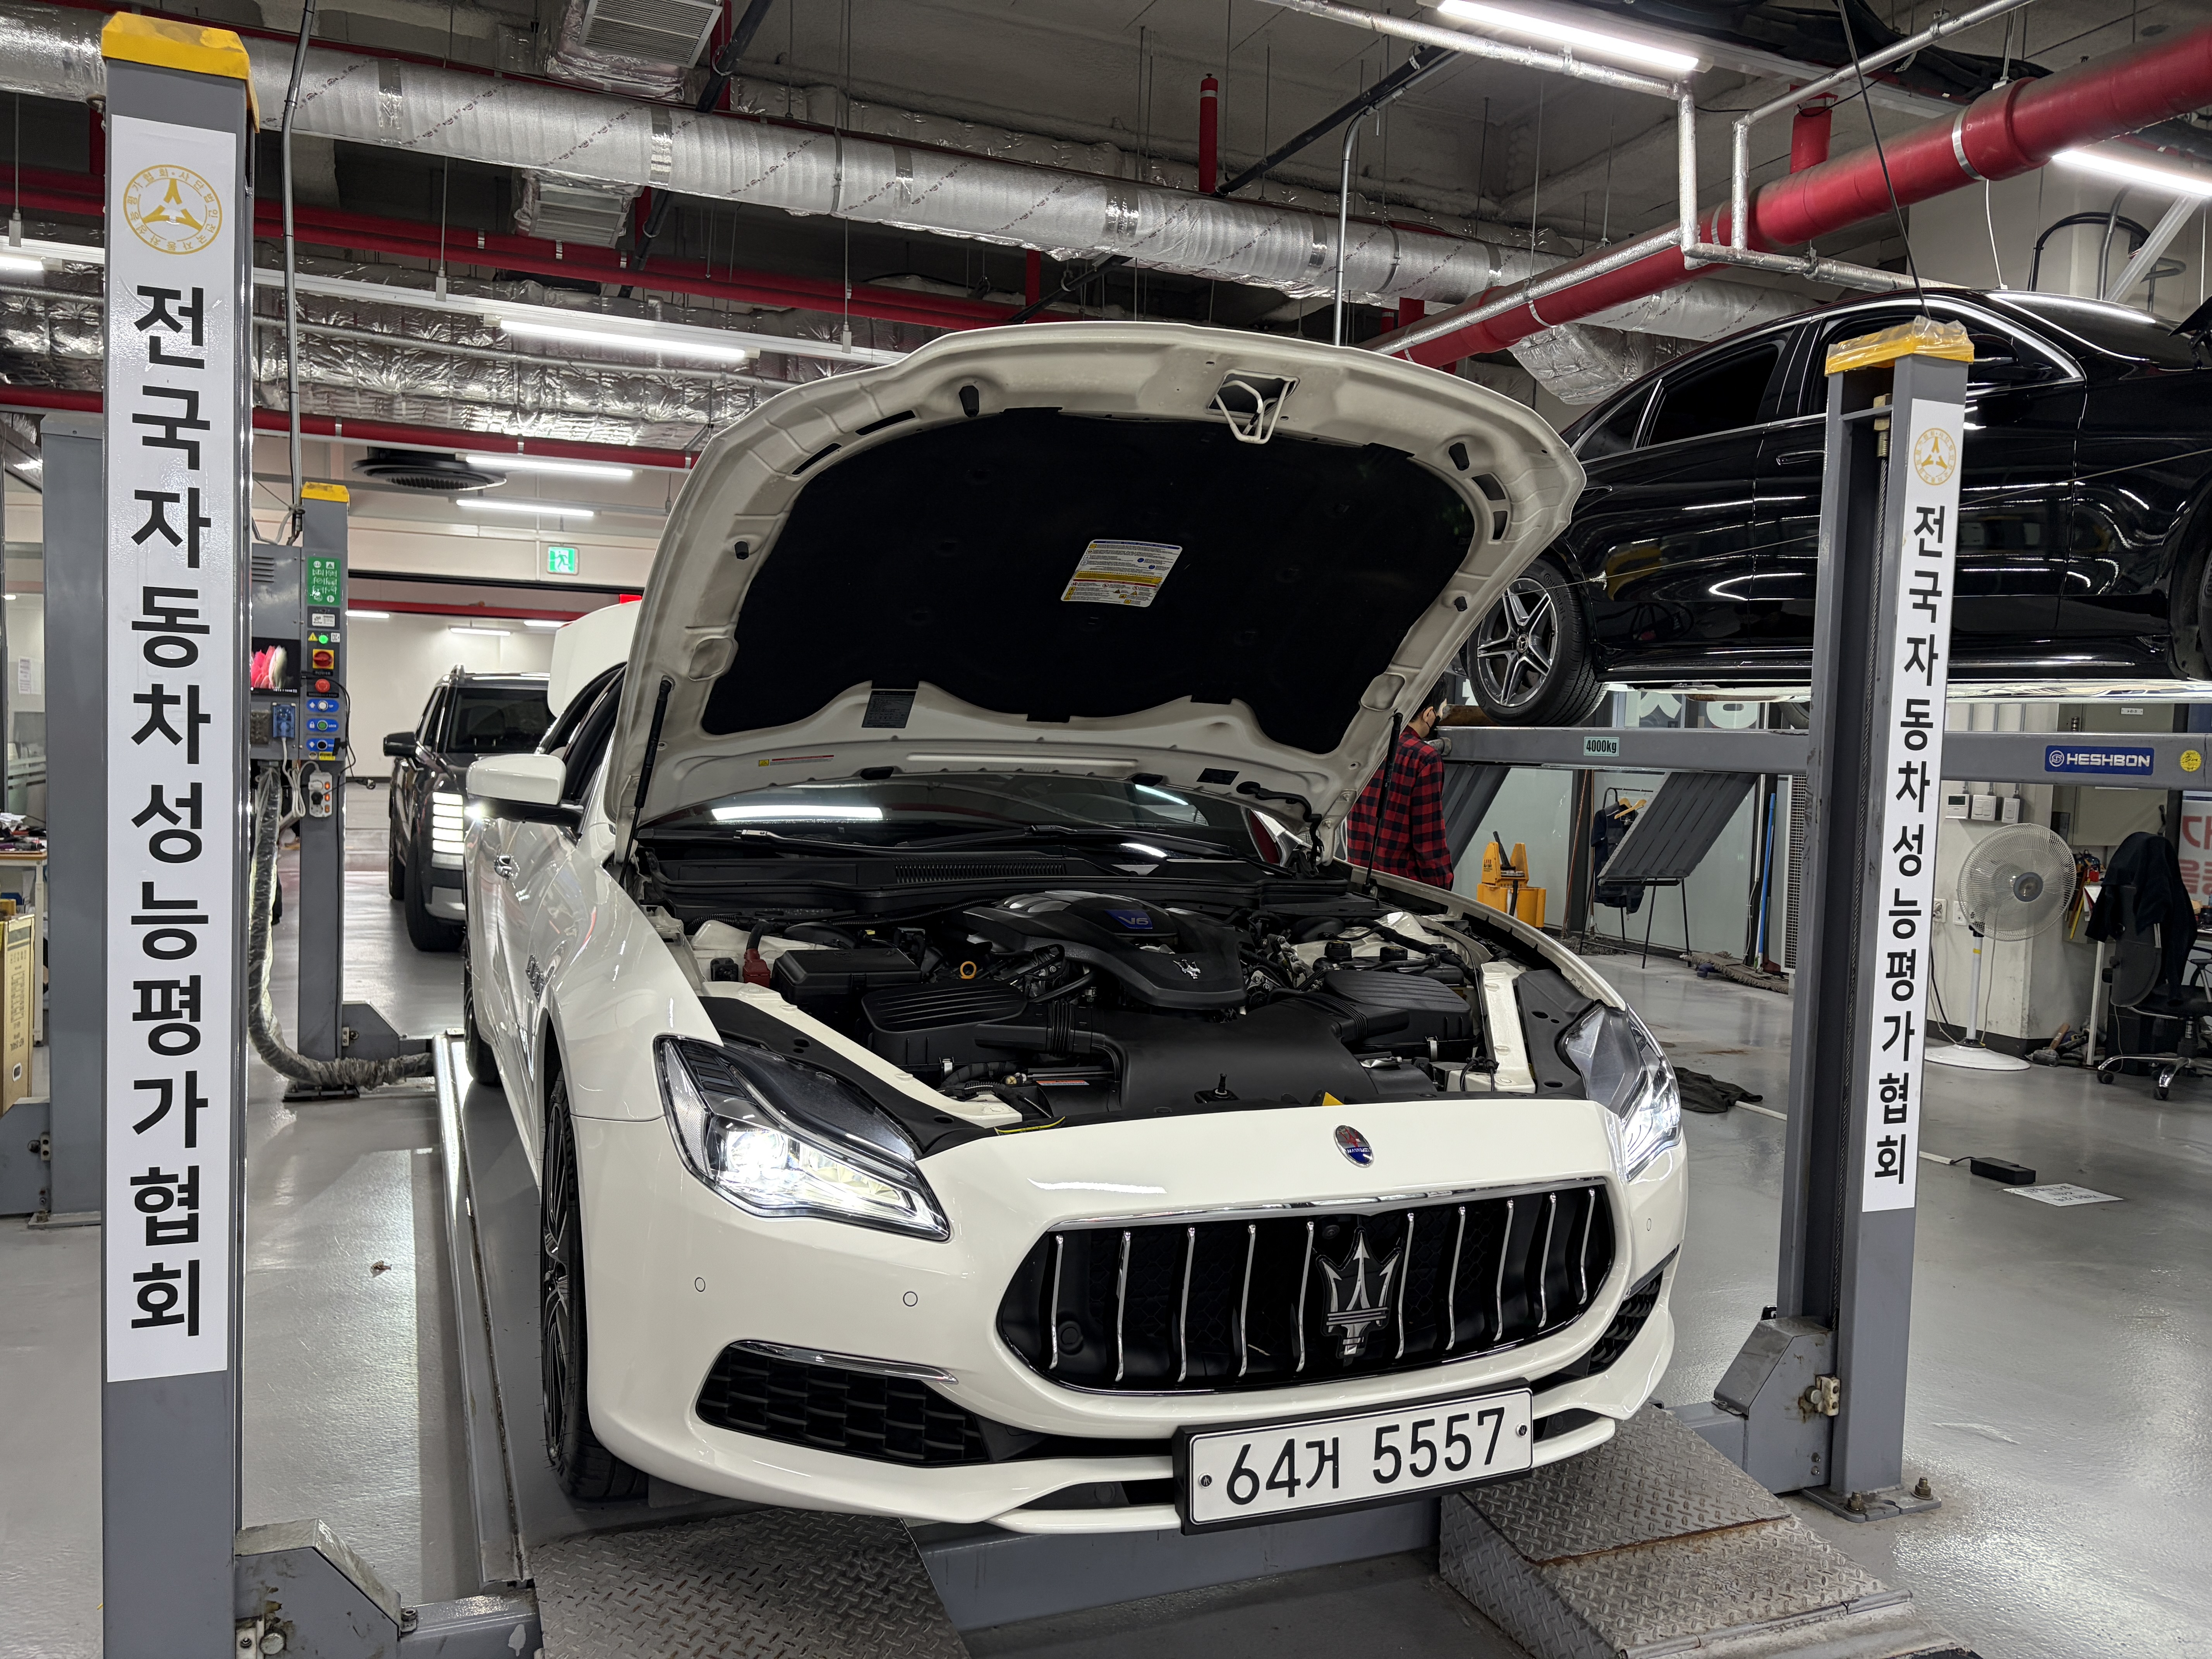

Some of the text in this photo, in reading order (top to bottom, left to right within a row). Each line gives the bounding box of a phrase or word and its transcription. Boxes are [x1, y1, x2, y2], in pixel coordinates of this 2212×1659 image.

[1586, 740, 1617, 754] 4000kg
[2066, 753, 2150, 767] HESHBON
[130, 285, 211, 1336] 전국자동차성능평가협회
[1874, 505, 1945, 1184] 전국자동차성능평가협회
[1118, 916, 1149, 925] V6
[1227, 1407, 1505, 1505] 64거 5557
